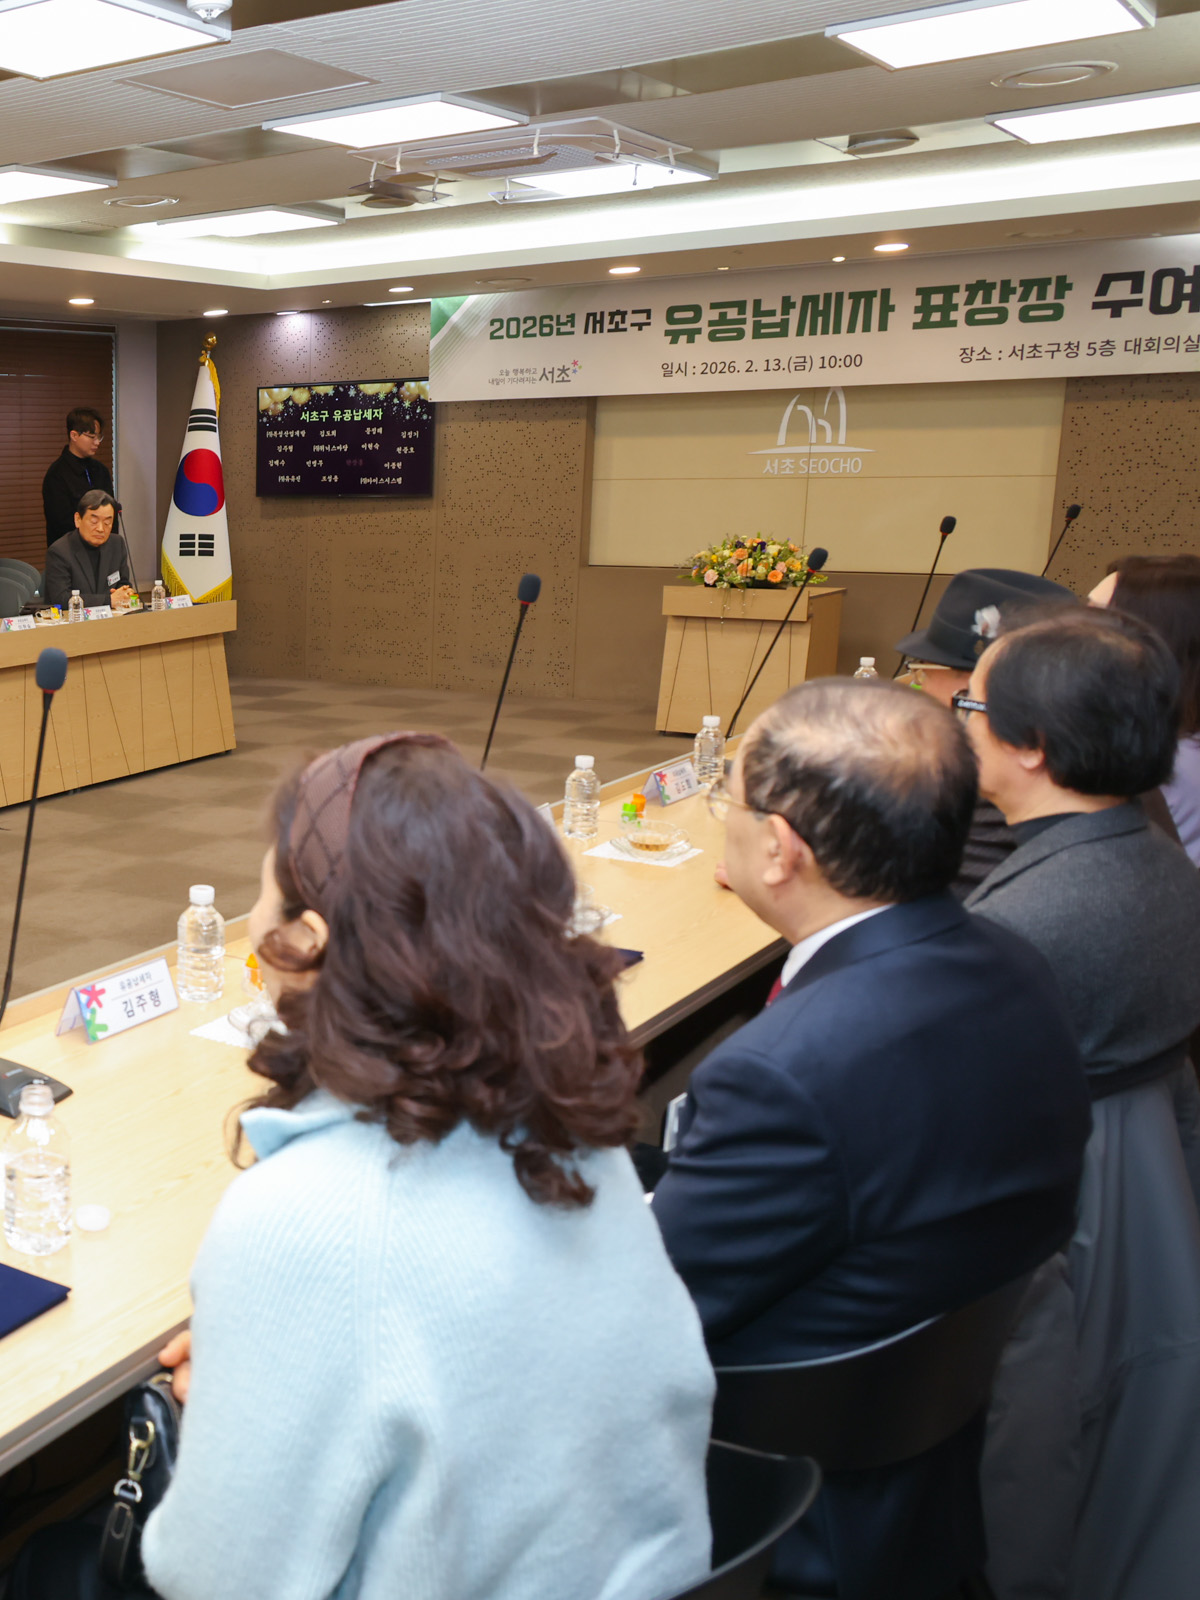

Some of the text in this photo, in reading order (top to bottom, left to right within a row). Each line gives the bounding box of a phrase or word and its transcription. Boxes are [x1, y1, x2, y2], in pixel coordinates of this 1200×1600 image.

[489, 312, 576, 340] 2026년
[583, 308, 652, 335] 서초구
[664, 288, 896, 345] 유공납세자
[912, 275, 1074, 330] 표창장
[959, 346, 993, 364] 장소
[1008, 340, 1081, 361] 서초구청
[1086, 339, 1117, 357] 5층
[1123, 334, 1200, 356] 대회의실
[539, 365, 571, 384] 서초
[661, 361, 689, 378] 일시
[700, 361, 742, 376] 2026.
[763, 353, 814, 373] 13.(금)
[819, 353, 863, 370] 10:00
[300, 408, 384, 423] 서초구 유공납세자
[763, 457, 862, 475] 서초 SEOCHO
[122, 988, 161, 1018] 김주형
